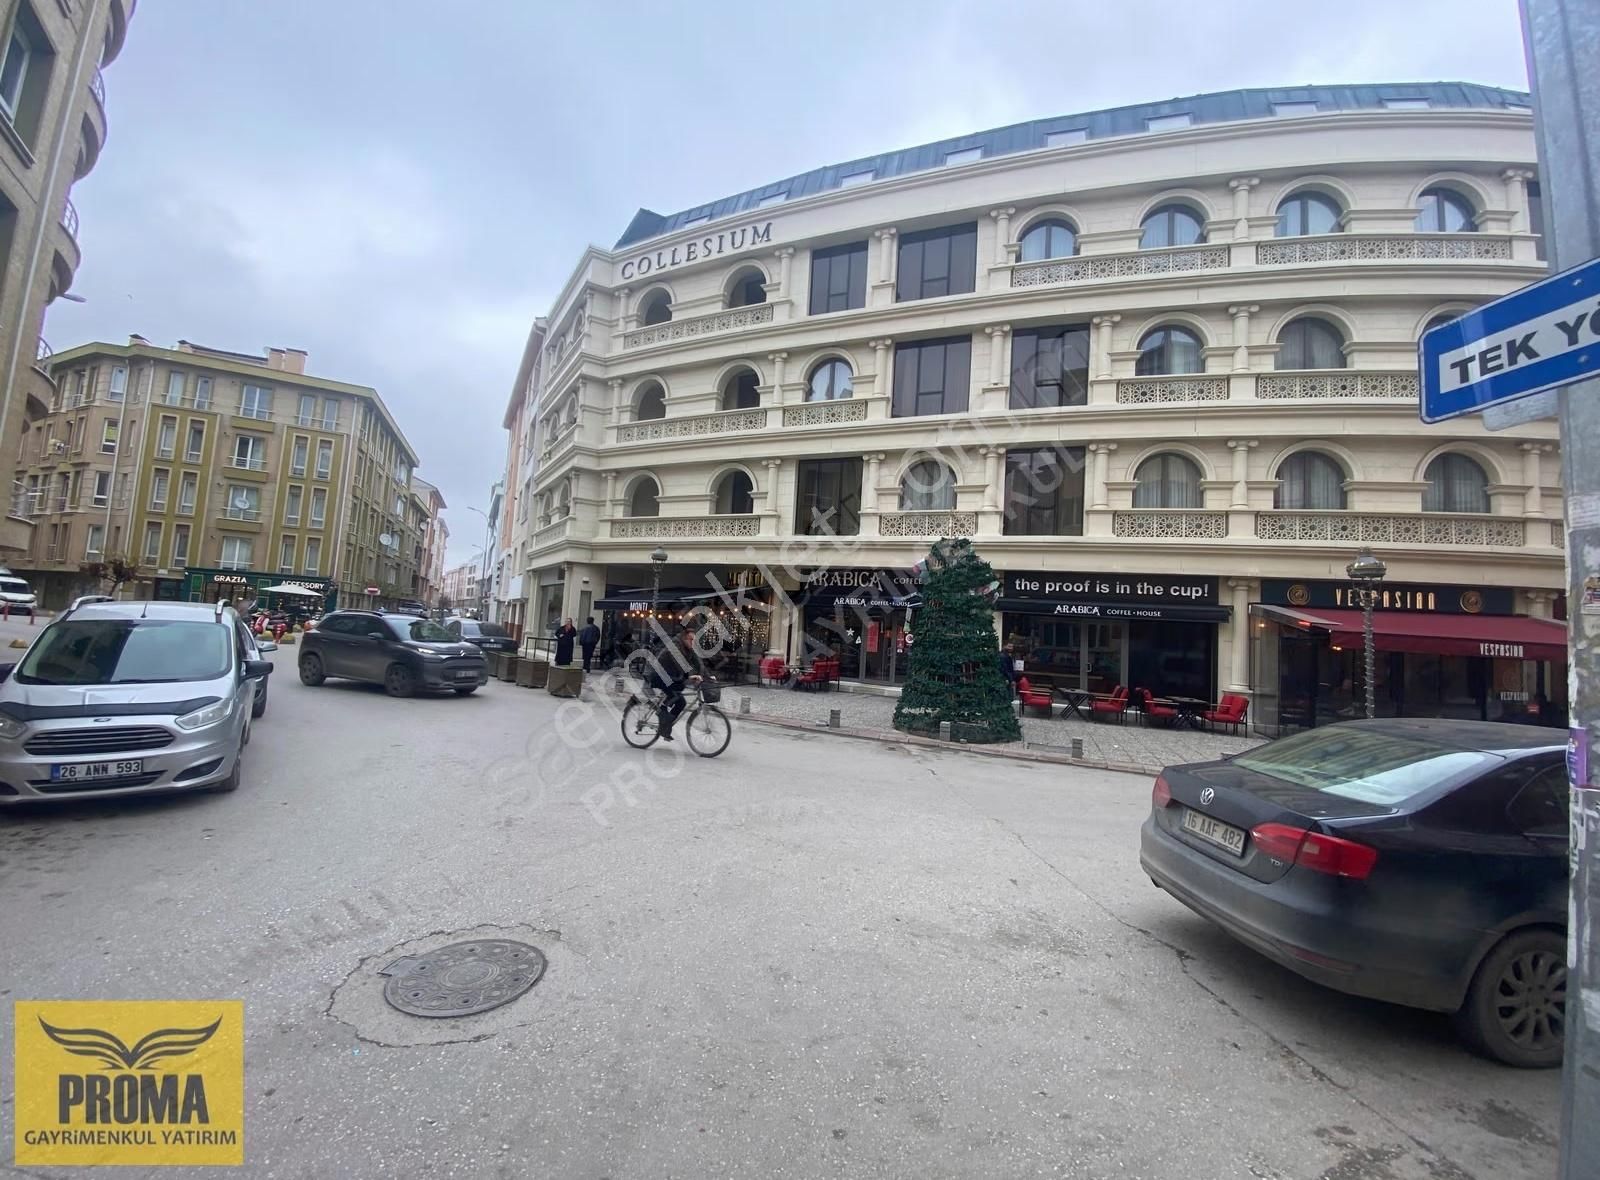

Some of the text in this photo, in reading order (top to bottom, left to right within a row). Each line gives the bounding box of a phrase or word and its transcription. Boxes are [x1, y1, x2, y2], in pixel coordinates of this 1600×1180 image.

[621, 222, 773, 280] COLLESIUM
[1450, 330, 1540, 384] TEK
[213, 574, 247, 584] GRAZIA
[804, 571, 883, 592] ARABICA
[1015, 579, 1209, 600] the proof is in the cup!
[833, 597, 866, 607] ARABICA
[1336, 588, 1435, 610] VESPASIAN
[1054, 604, 1162, 618] ARABICA COFFEE HOUSE
[1480, 643, 1524, 658] VESPASIAN
[61, 761, 141, 778] 26 ANN 593
[1188, 812, 1243, 849] 16 AAF 482
